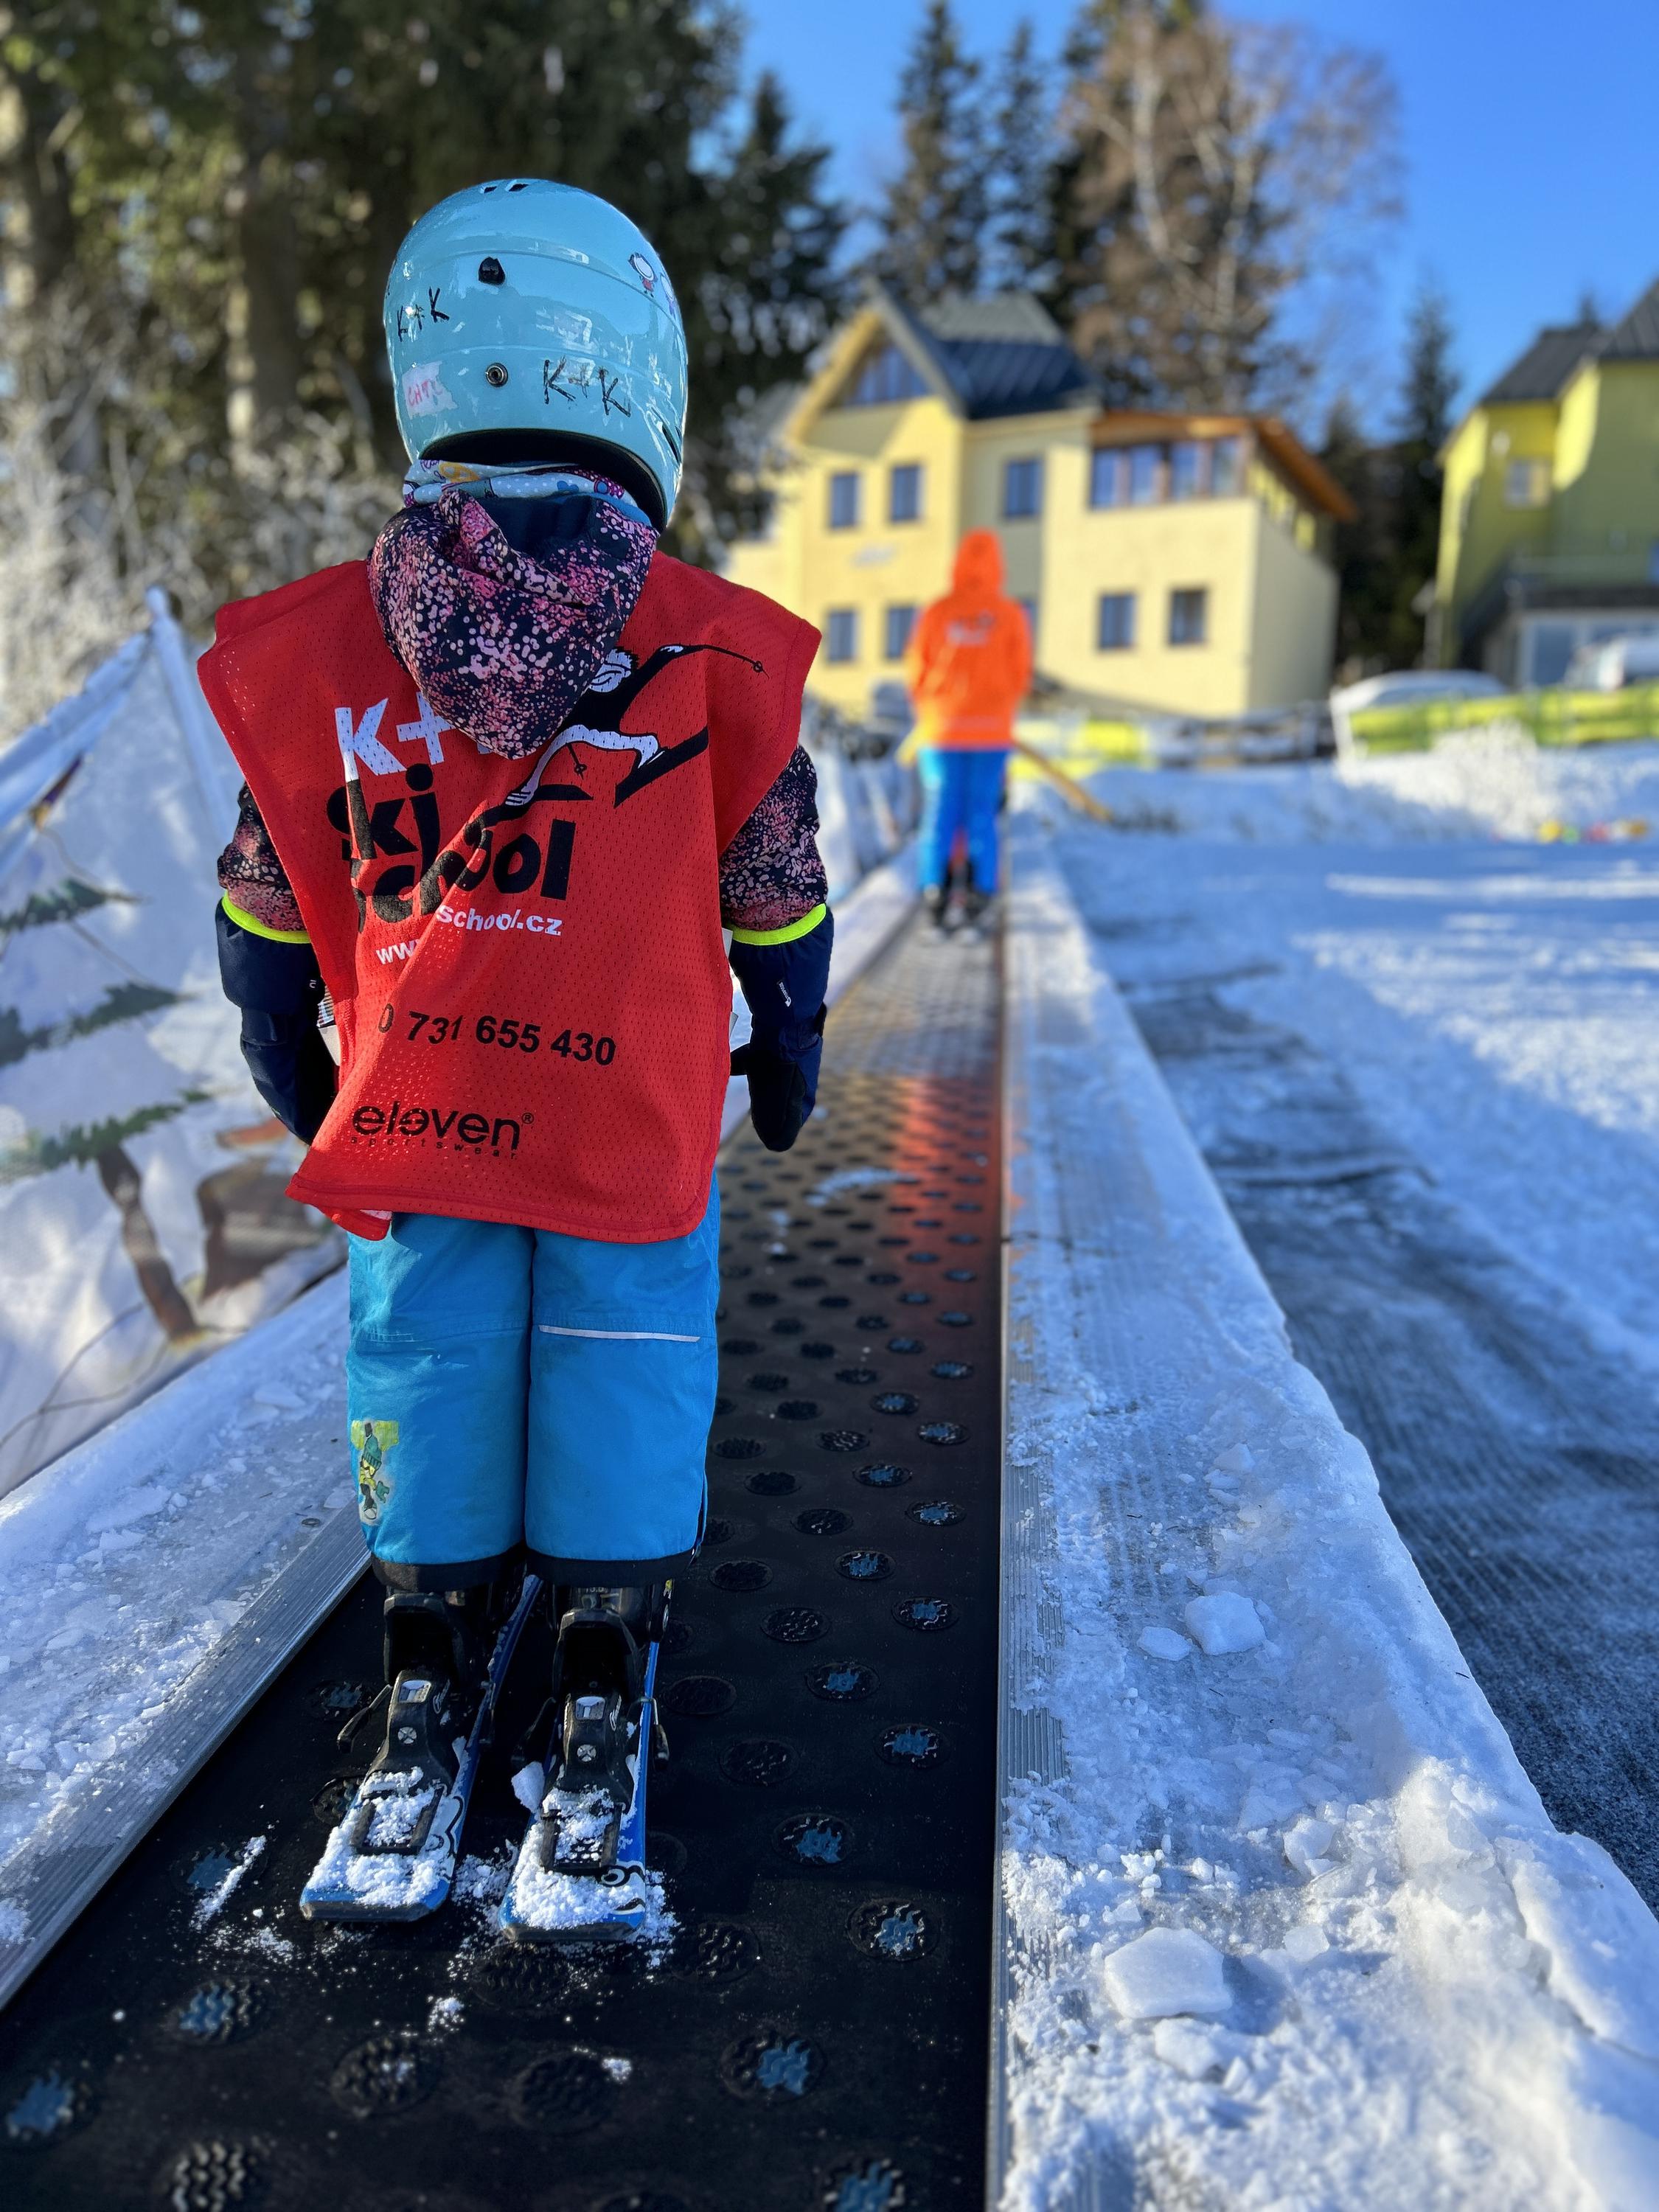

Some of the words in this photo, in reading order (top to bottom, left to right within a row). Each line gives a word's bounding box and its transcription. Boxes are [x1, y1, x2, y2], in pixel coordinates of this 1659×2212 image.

[543, 355, 631, 417] K+K
[408, 1010, 463, 1045] 731
[476, 1015, 541, 1053] 655
[551, 1029, 616, 1065] 430
[350, 1135, 518, 1161] sportswear
